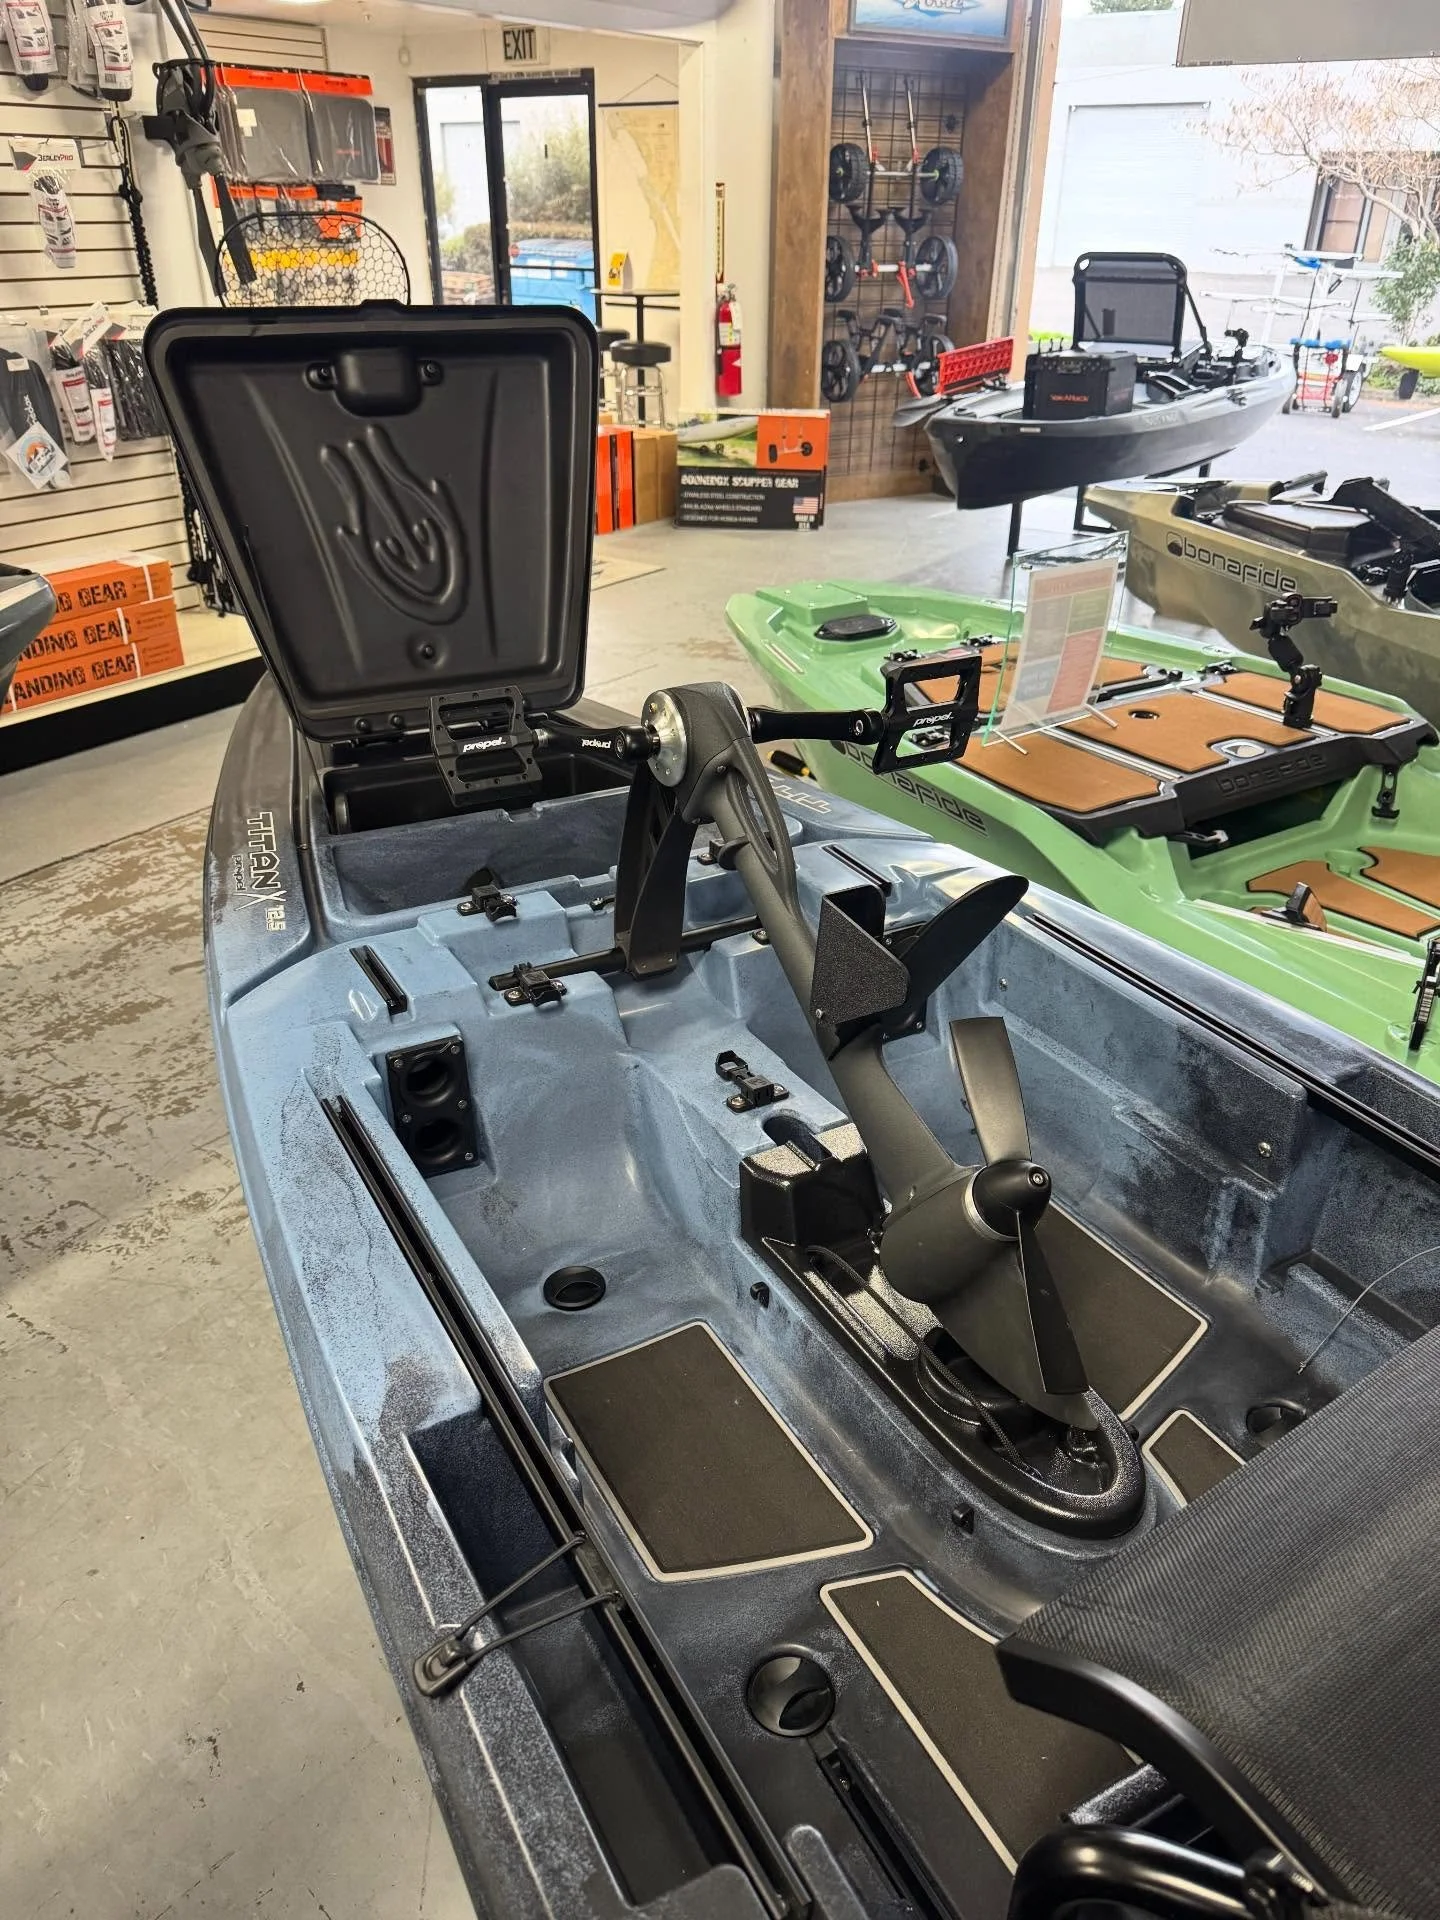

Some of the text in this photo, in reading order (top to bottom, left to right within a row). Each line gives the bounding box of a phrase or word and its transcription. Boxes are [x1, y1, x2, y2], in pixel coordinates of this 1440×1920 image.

[503, 29, 535, 60] EXIT
[732, 476, 773, 488] SCUPPER
[775, 478, 799, 488] GEAR
[1183, 537, 1298, 592] bonafide
[78, 580, 127, 608] GEAR
[20, 630, 78, 661] NDING
[5, 666, 87, 704] ANDING
[91, 653, 137, 681] GEAR
[913, 711, 952, 727] propel
[463, 736, 503, 753] propel
[581, 738, 612, 750] propel
